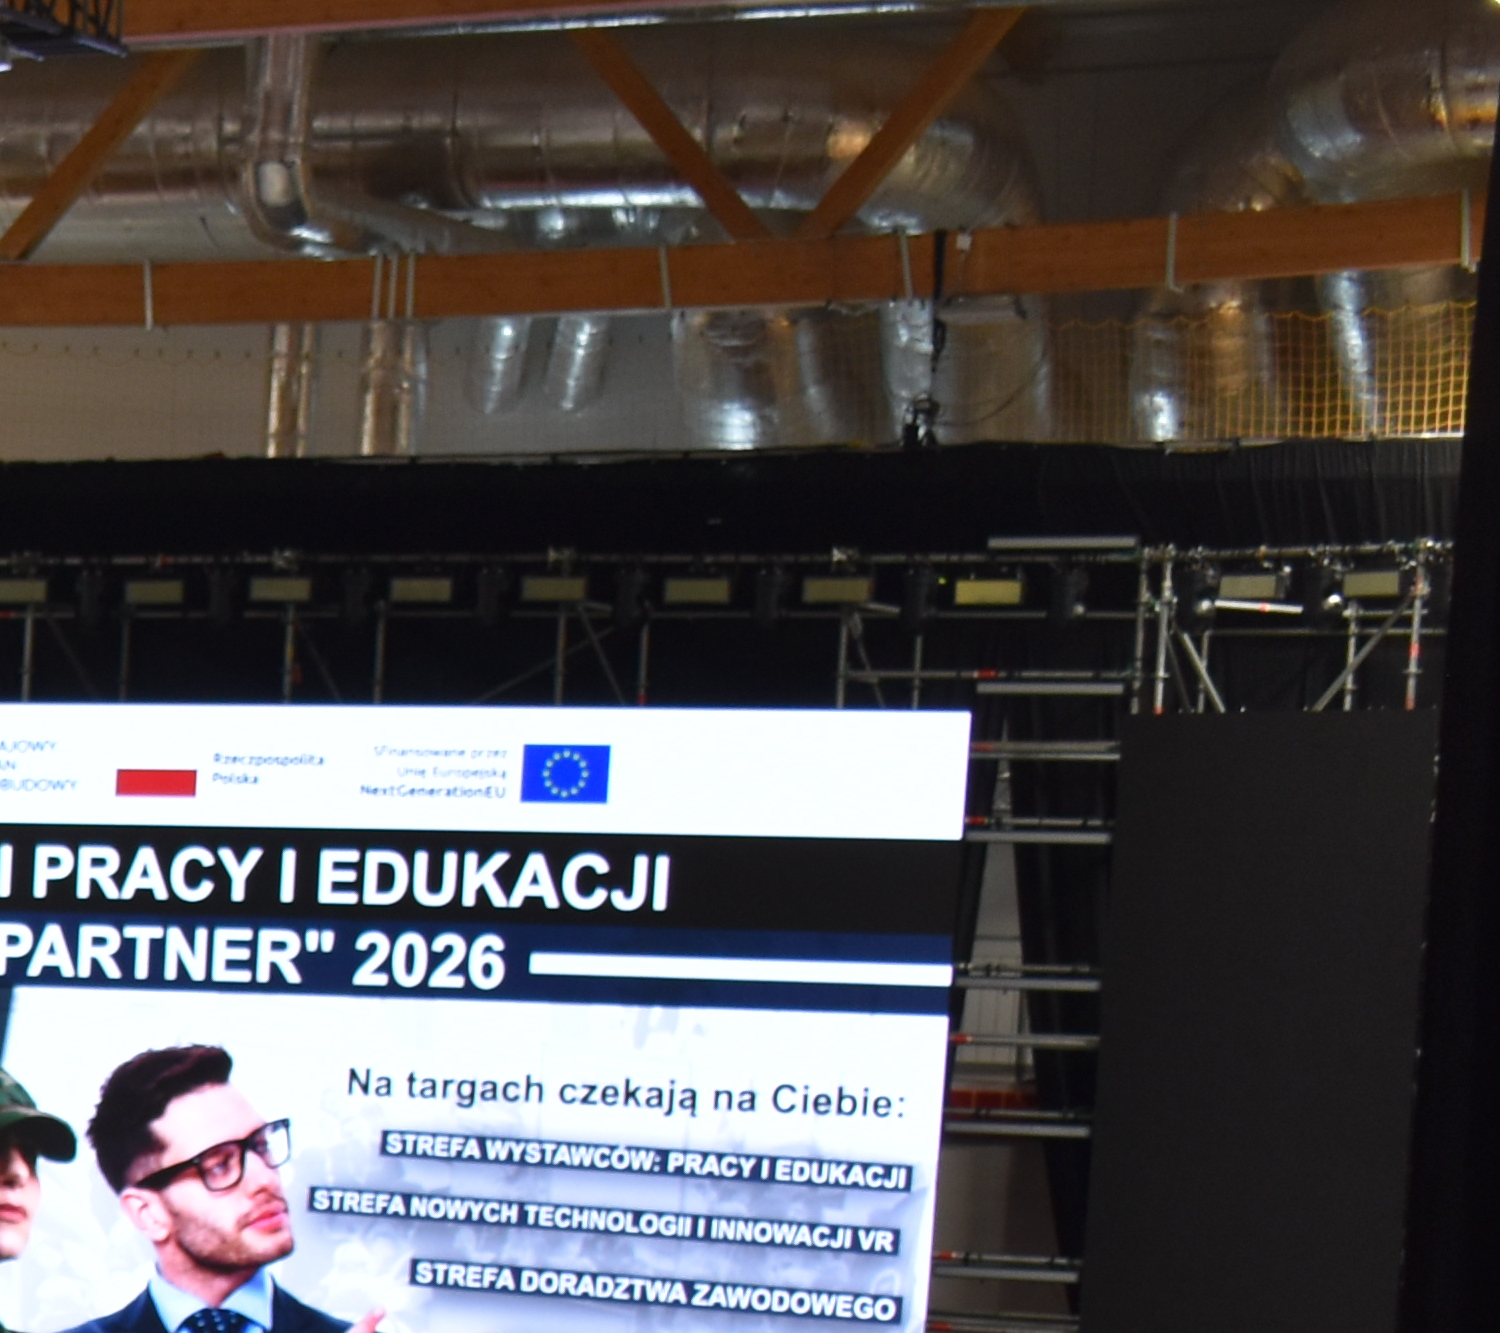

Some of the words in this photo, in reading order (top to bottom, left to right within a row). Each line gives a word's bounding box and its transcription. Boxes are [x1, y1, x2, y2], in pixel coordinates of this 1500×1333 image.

[212, 772, 260, 785] Polska
[360, 783, 507, 800] NextGenerationEU
[33, 844, 264, 903] PRACY
[279, 848, 297, 903] I
[315, 848, 671, 911] EDUKACJI
[351, 929, 506, 990] 2026
[348, 1069, 393, 1097] Na
[407, 1071, 544, 1108] targach
[558, 1076, 699, 1117] czekają
[713, 1087, 756, 1112] na
[772, 1084, 906, 1117] Ciebie:
[384, 1133, 481, 1161] STREFA
[485, 1137, 661, 1173] WYSTAWCÓW:
[667, 1152, 756, 1180] PRACY
[760, 1158, 772, 1180] I
[775, 1159, 907, 1190] EDUKACJI
[313, 1189, 405, 1217] STREFA
[410, 1195, 519, 1225] NOWYCH
[524, 1203, 691, 1238] TECHNOLOGII
[696, 1214, 706, 1238] I
[710, 1216, 852, 1249] INNOWACJI
[857, 1227, 893, 1252] VR
[415, 1261, 515, 1290] STREFA
[520, 1269, 688, 1305] DORADZTWA
[692, 1283, 896, 1323] ZAWODOWEGO
